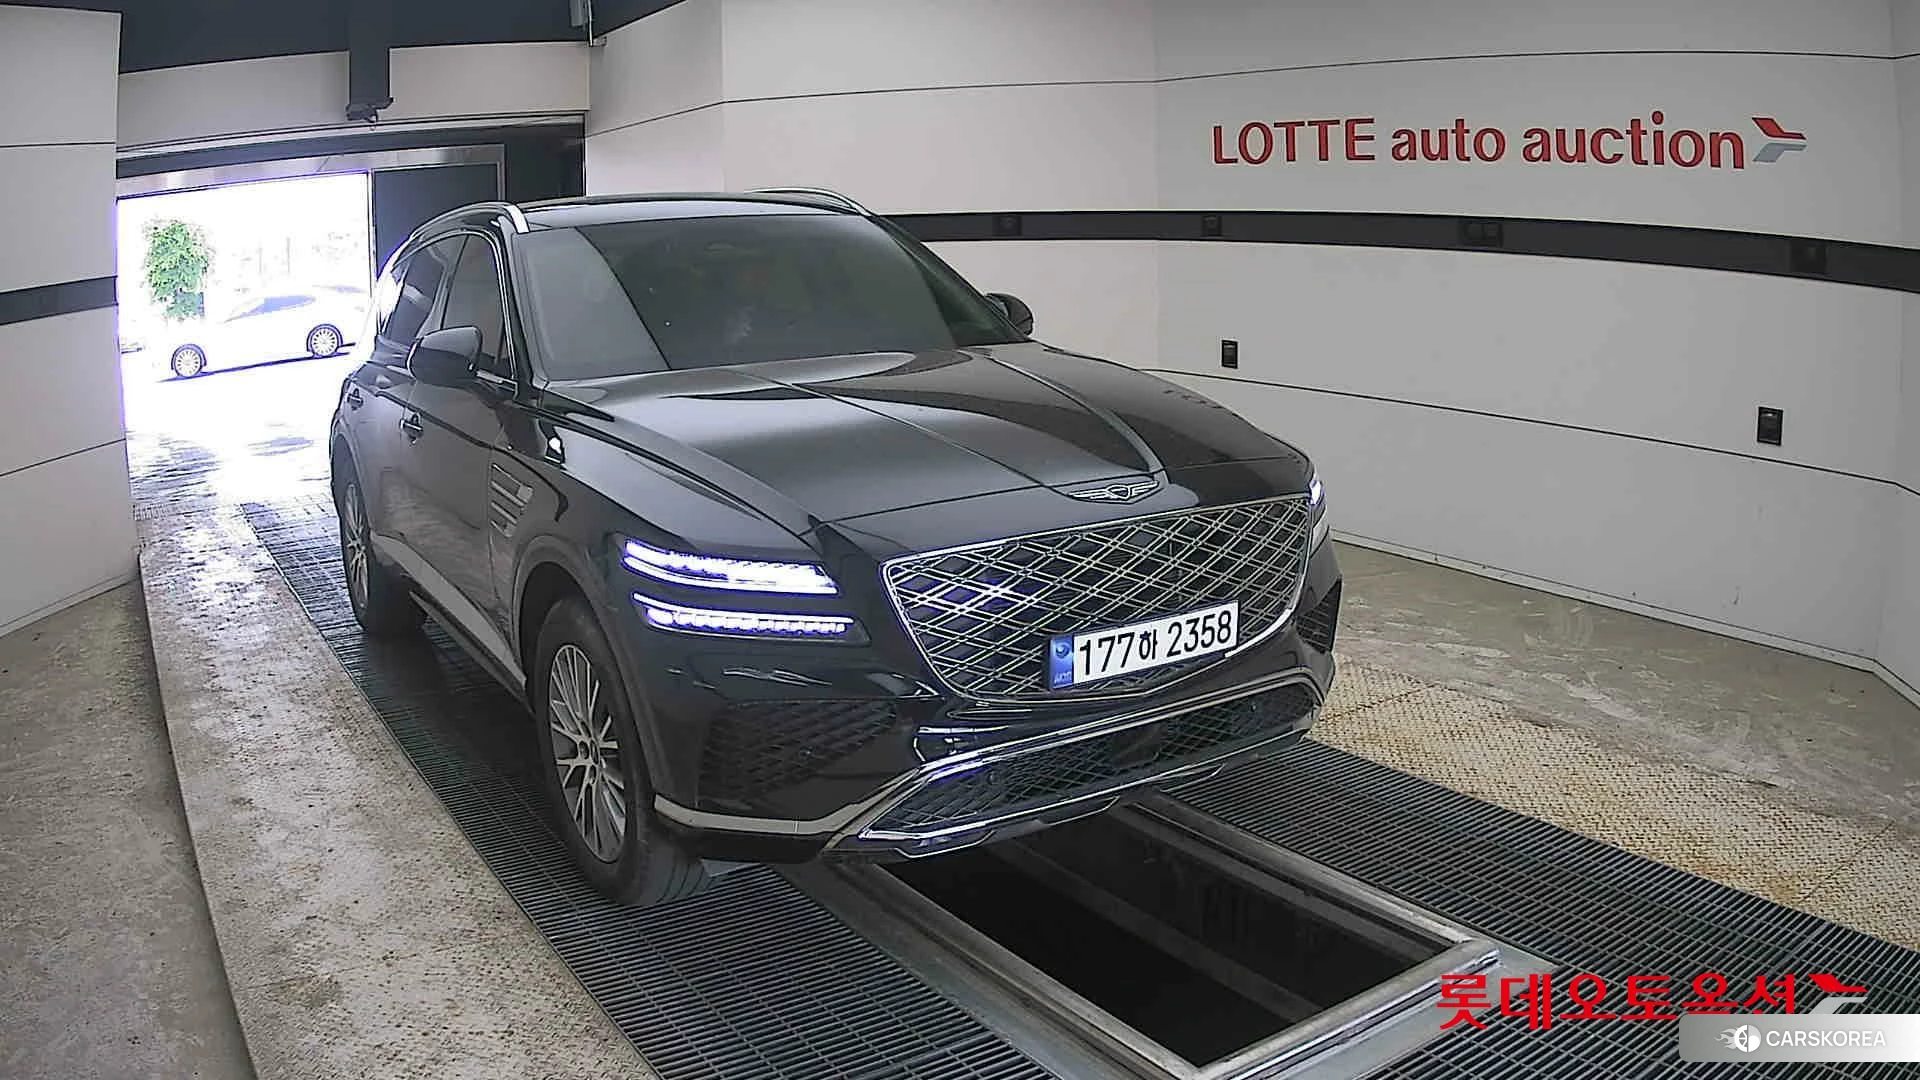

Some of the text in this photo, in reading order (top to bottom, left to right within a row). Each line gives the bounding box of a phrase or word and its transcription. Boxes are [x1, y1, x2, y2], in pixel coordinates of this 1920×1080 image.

[1213, 111, 1745, 169] LOTTE auto auction
[1079, 610, 1231, 675] 177하 2358
